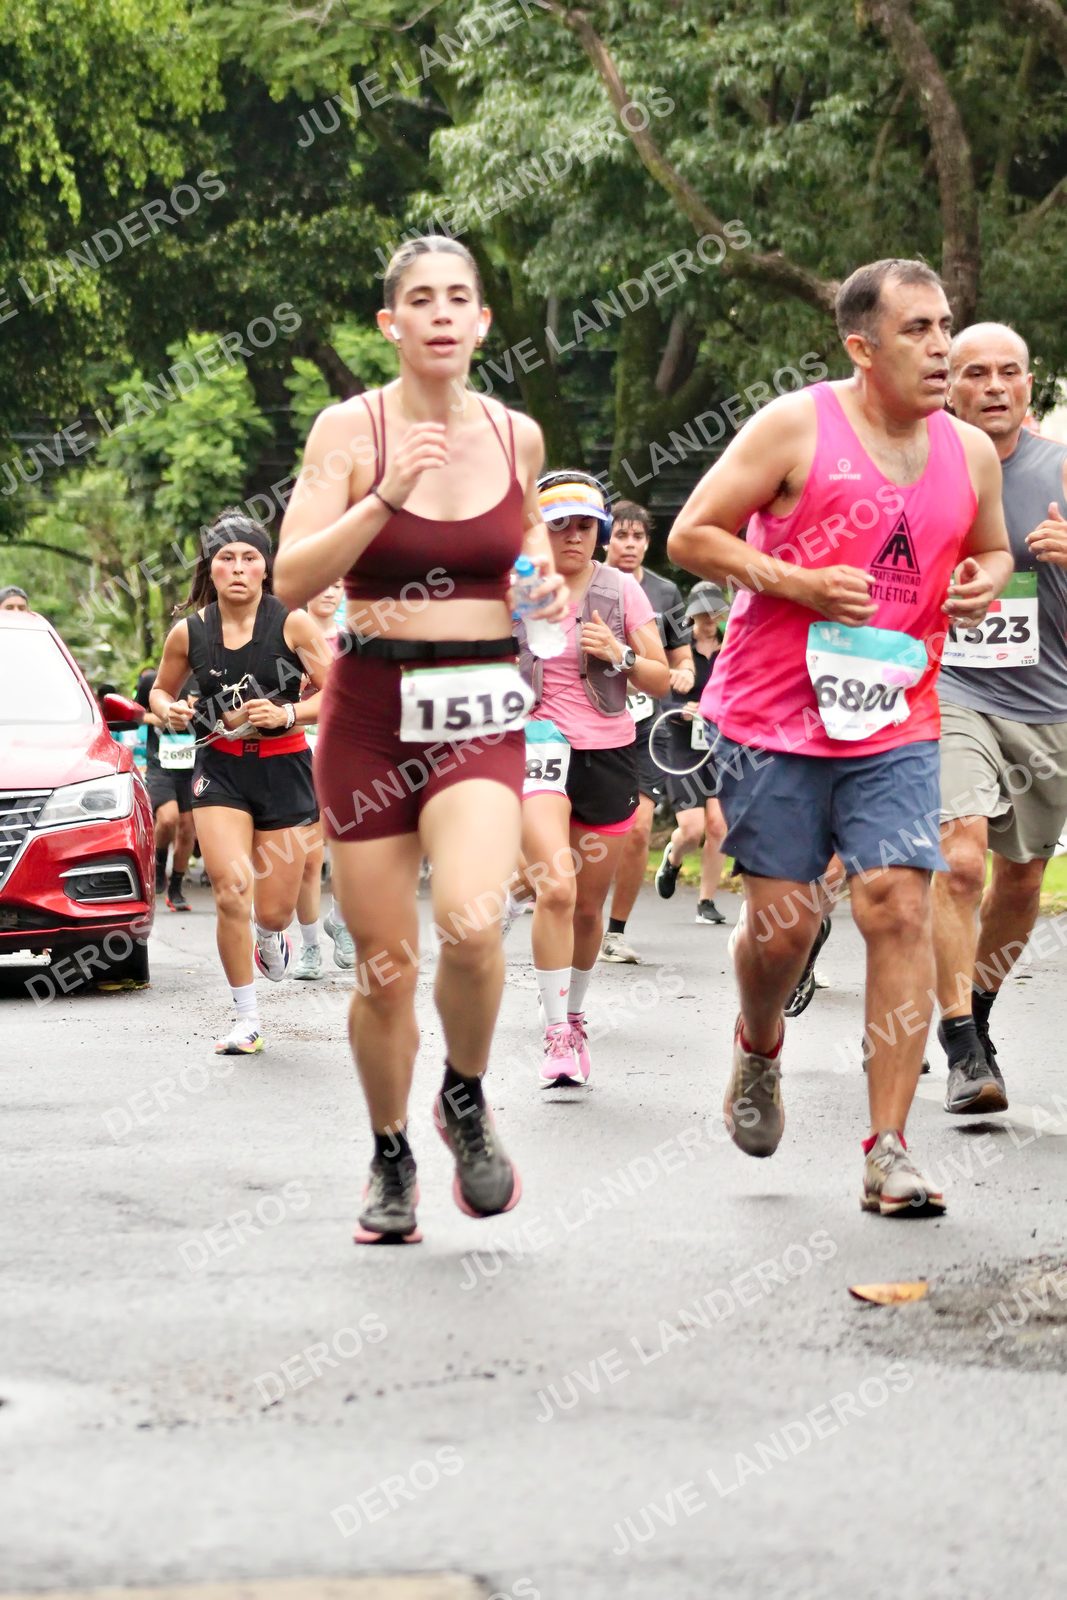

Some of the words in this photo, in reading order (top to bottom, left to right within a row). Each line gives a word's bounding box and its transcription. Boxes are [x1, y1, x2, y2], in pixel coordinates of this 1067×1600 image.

[870, 569, 921, 587] FRATERNIDAD
[814, 675, 903, 712] 6800
[417, 691, 525, 730] 1519
[526, 758, 561, 782] 85
